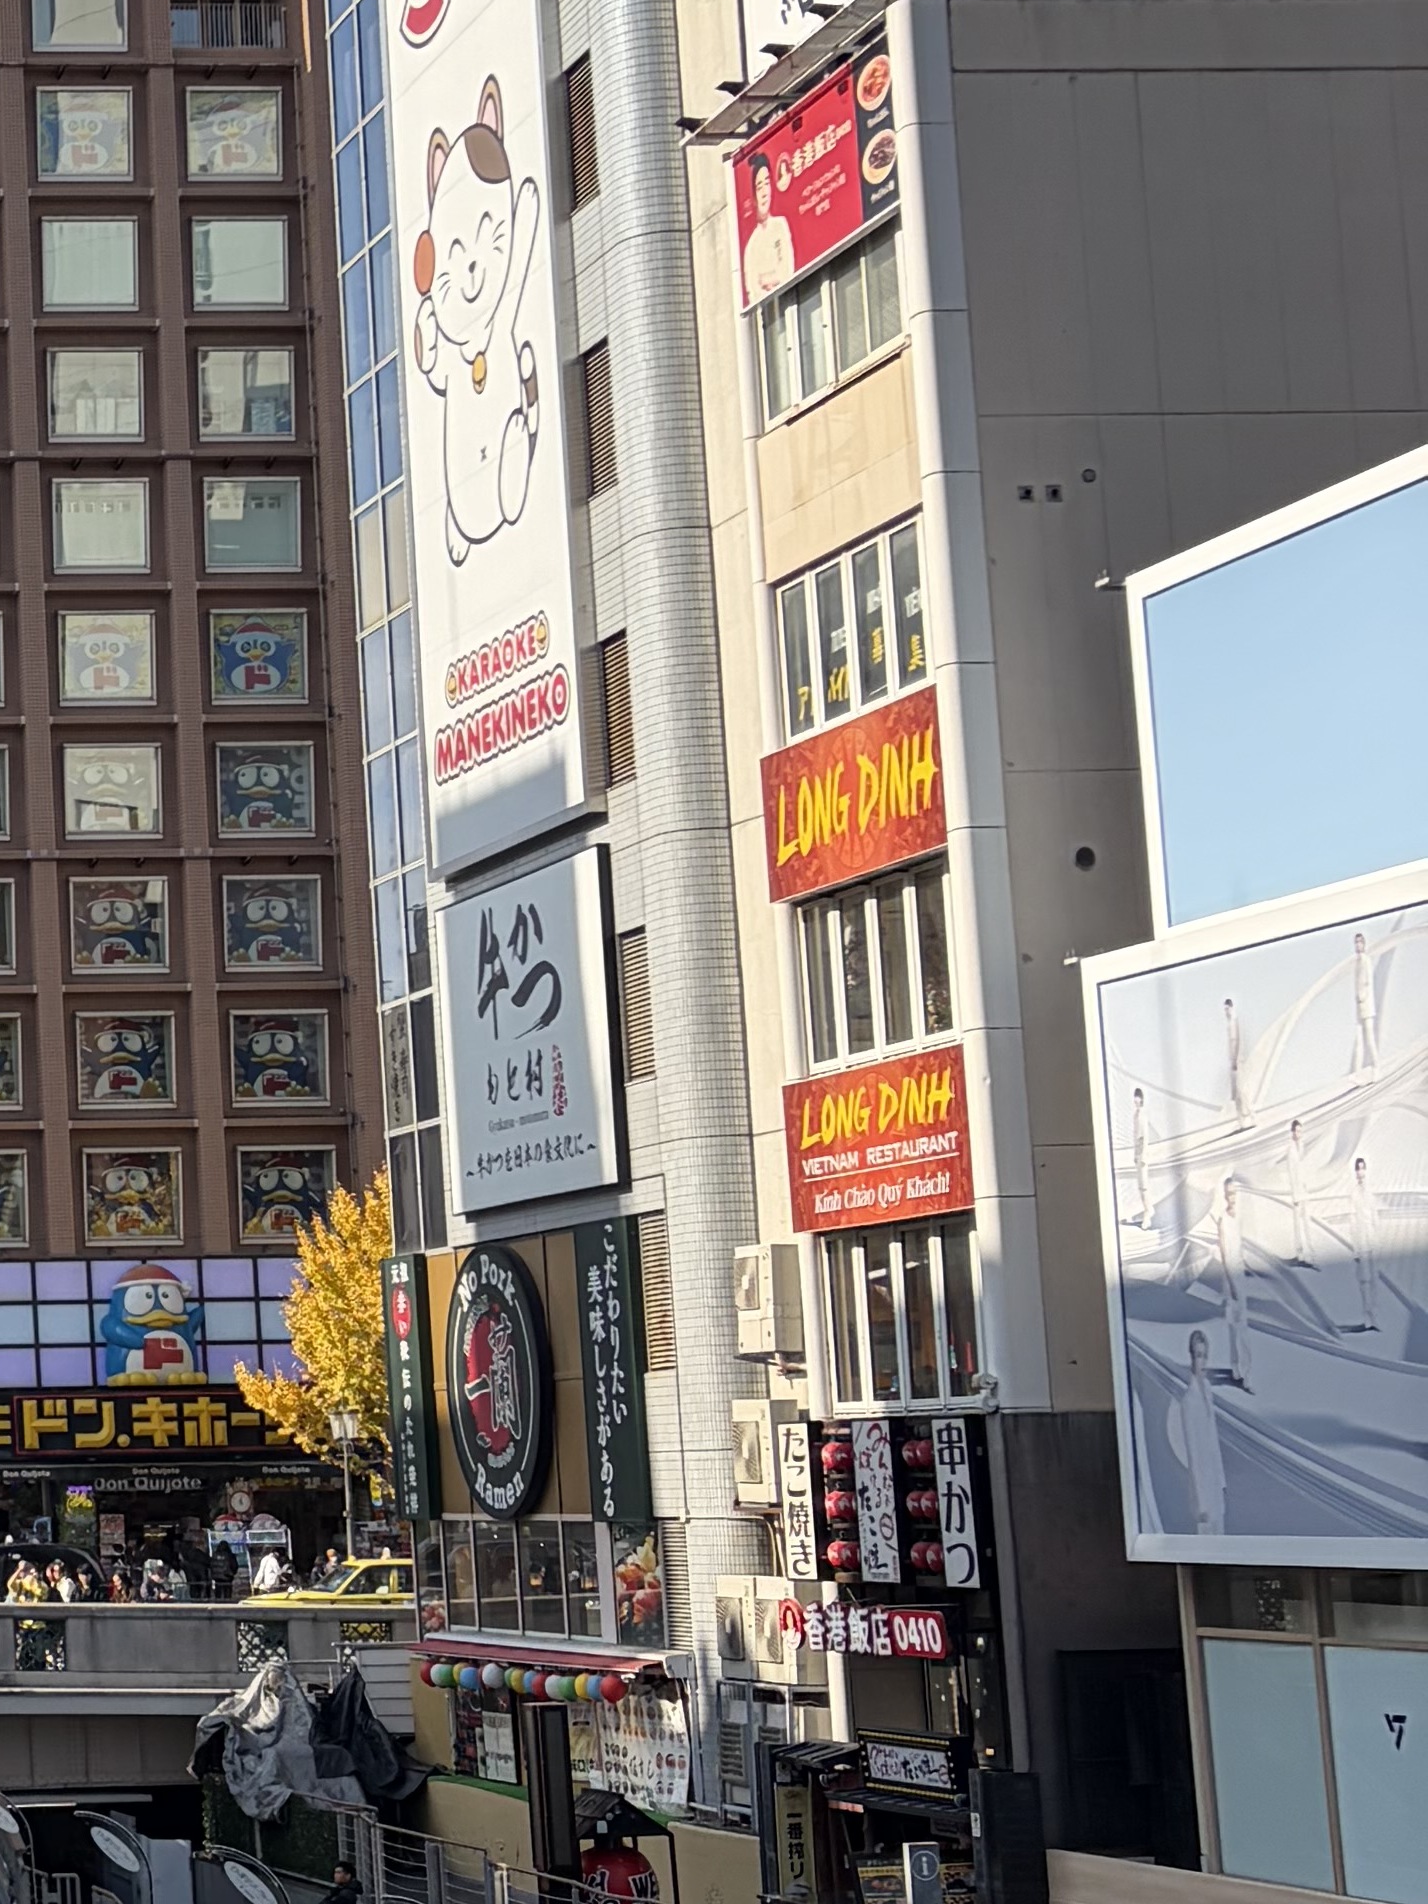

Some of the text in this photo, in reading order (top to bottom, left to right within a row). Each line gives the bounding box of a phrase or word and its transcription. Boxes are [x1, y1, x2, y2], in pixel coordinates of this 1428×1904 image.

[455, 629, 539, 706] KARAOKE
[436, 665, 570, 786] MANEKINEKO
[776, 724, 940, 869] LONG DINH
[800, 1066, 955, 1150] LONG DINH
[801, 1131, 959, 1176] VIETNAM RESTAURANT
[457, 1253, 517, 1313] No Pork
[603, 1224, 628, 1425] こだわりたい
[587, 1265, 615, 1518] 美味しさがある
[475, 1462, 524, 1510] Ramen
[782, 1427, 814, 1576] たこ焼き
[936, 1422, 976, 1586] 串かつ
[804, 1603, 942, 1656] 香港飯店 0410
[787, 1812, 804, 1880] 一番搾り
